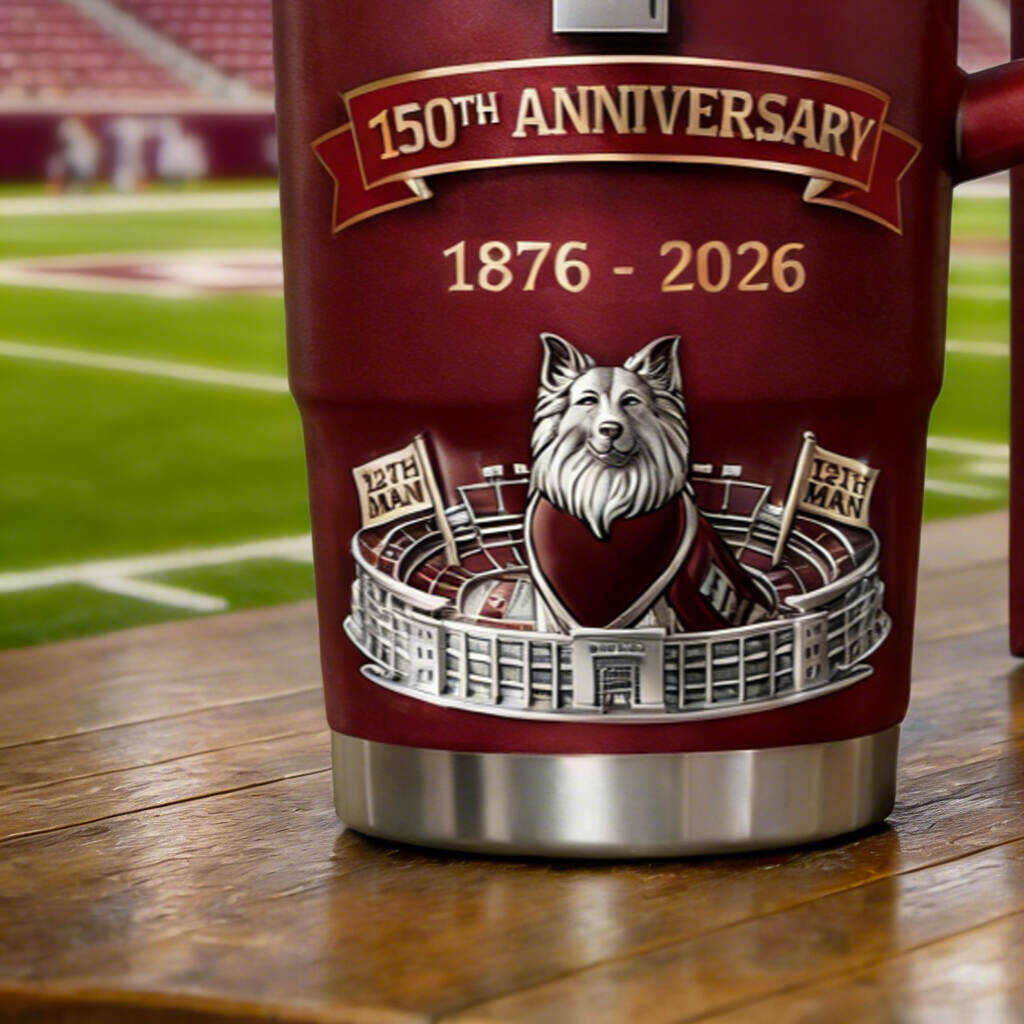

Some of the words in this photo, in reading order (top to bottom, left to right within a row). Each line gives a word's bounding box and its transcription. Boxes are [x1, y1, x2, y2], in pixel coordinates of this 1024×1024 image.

[368, 91, 500, 161] 150TH
[512, 84, 876, 162] ANNIVERSARY
[443, 240, 590, 293] 1876
[660, 240, 806, 293] 2026
[368, 480, 424, 518] MAN
[803, 481, 864, 519] MAN
